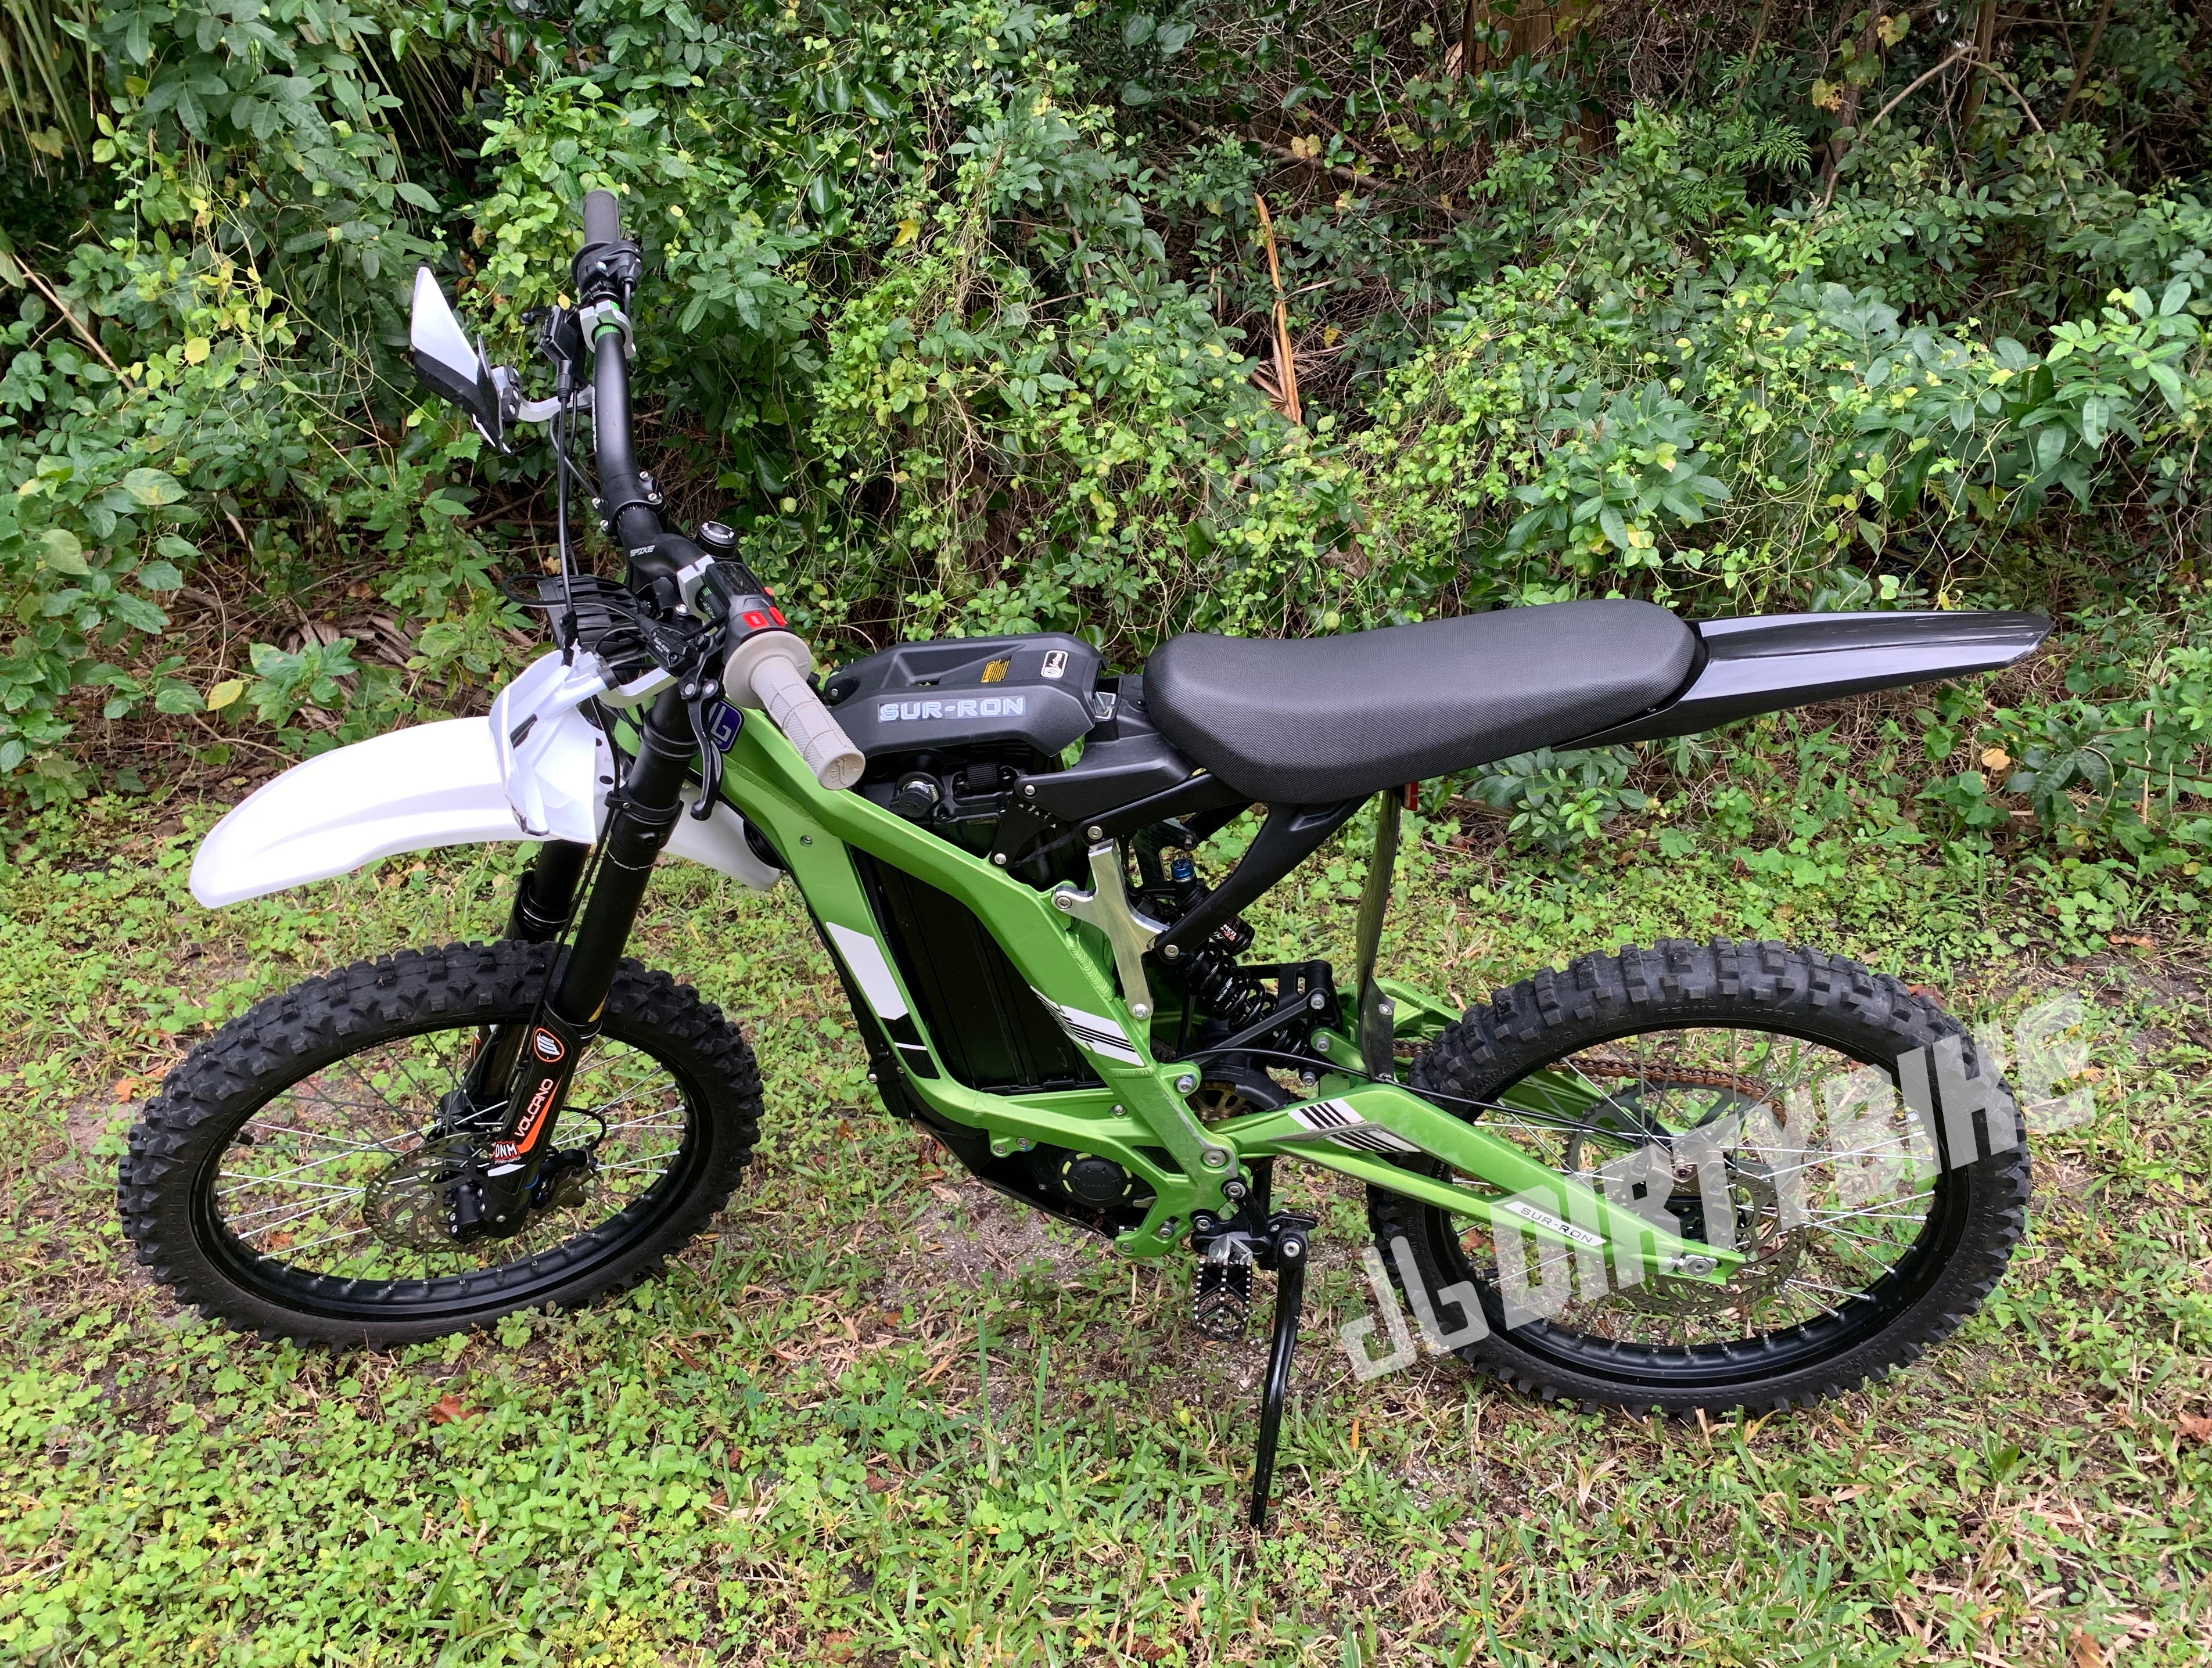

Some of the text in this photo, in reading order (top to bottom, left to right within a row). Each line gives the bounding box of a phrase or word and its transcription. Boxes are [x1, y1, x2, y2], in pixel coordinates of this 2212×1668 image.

[630, 545, 656, 558] SPIKE
[879, 697, 1024, 721] SUR-RON
[514, 1079, 554, 1137] VOLCANO
[495, 1142, 518, 1158] DNM
[1520, 1207, 1594, 1243] SUR-RON
